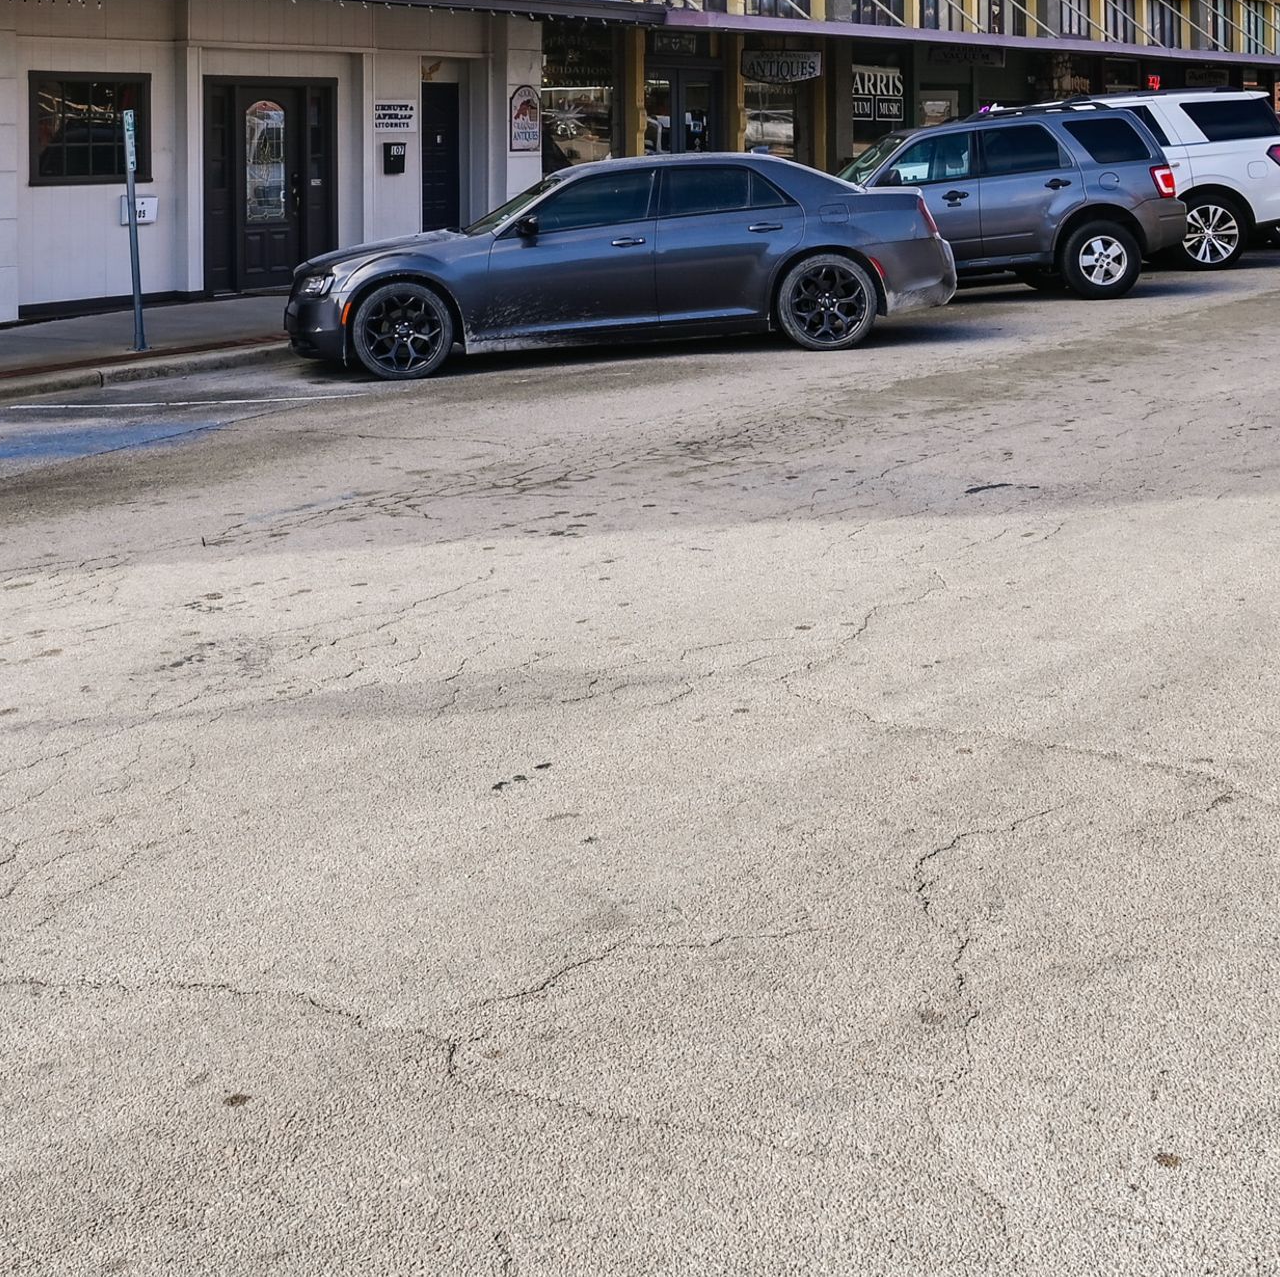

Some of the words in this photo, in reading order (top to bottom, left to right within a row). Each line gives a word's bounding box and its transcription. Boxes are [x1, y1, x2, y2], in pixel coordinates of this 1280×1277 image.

[748, 60, 817, 81] ANTIQUES
[852, 72, 904, 96] ARRIS
[375, 104, 409, 112] URNUTT
[879, 102, 901, 115] MUSIC
[513, 131, 538, 142] ANTIQUES
[392, 146, 403, 155] 107
